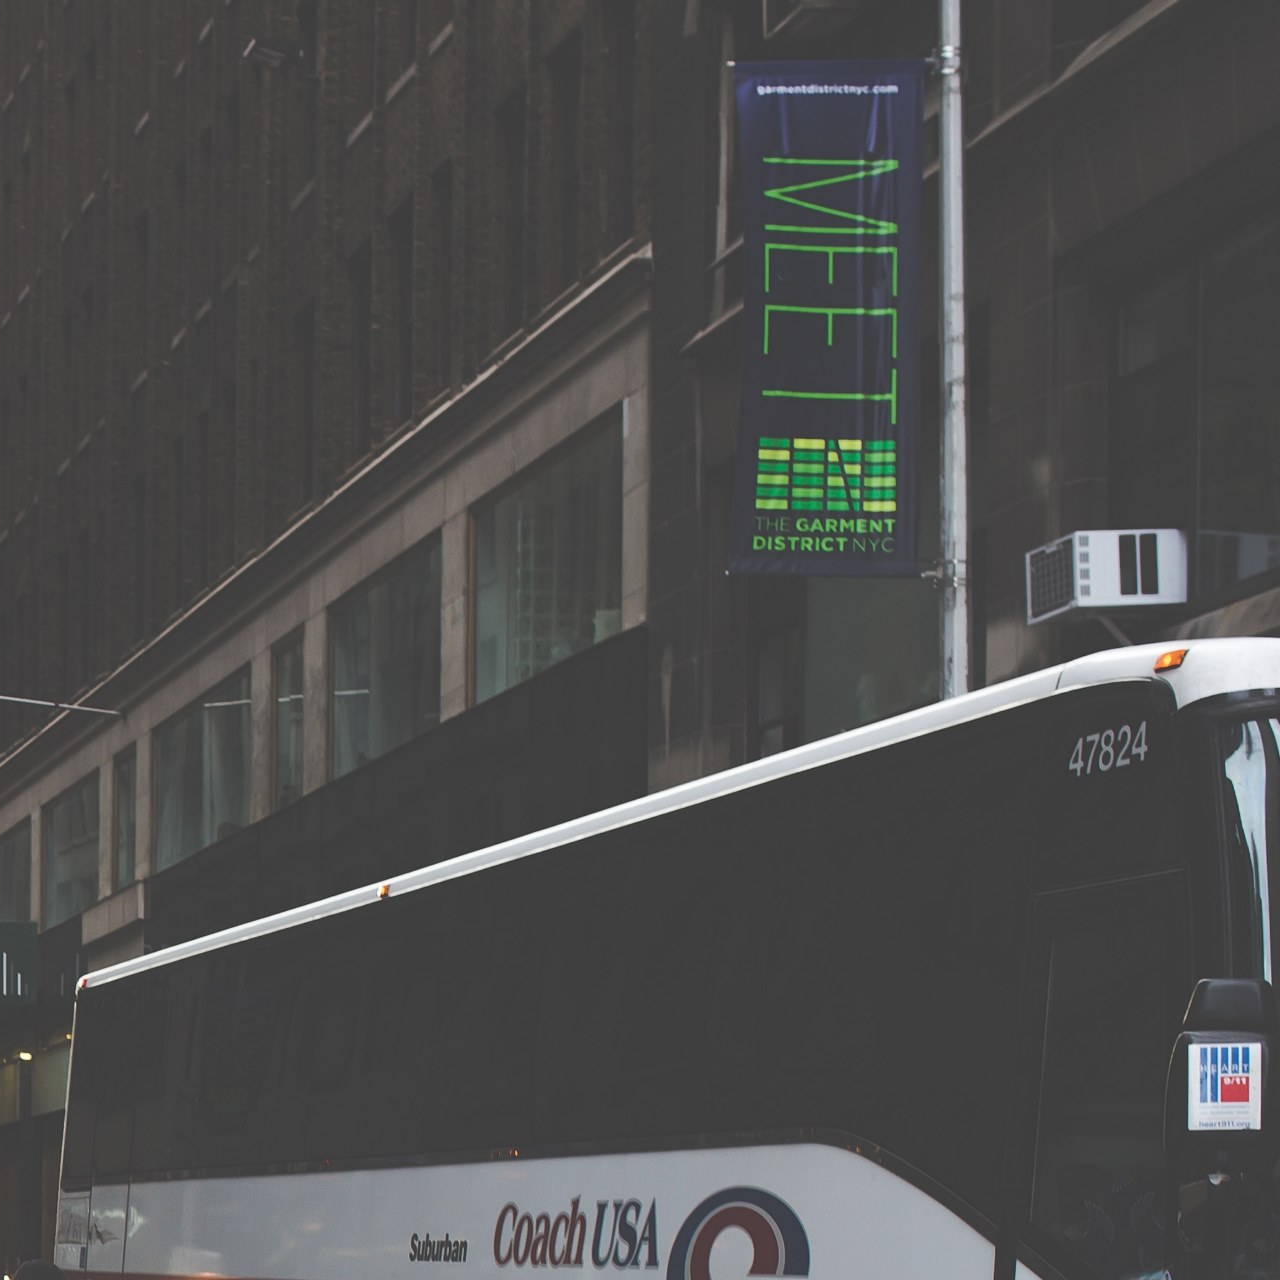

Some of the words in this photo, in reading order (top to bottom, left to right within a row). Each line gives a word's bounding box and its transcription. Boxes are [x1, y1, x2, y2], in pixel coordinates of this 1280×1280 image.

[756, 82, 899, 96] garmentdistrictnyc.com
[761, 157, 900, 425] MEET
[755, 516, 791, 532] THE
[795, 517, 897, 534] GARMENT
[752, 535, 848, 553] DISTRICT
[852, 536, 895, 553] NYC
[1068, 720, 1148, 777] 47824
[1199, 1063, 1249, 1074] HEART
[1198, 1119, 1251, 1131] heart911.org
[409, 1232, 469, 1264] Suburban
[493, 1194, 588, 1269] Coach
[591, 1197, 660, 1269] USA
